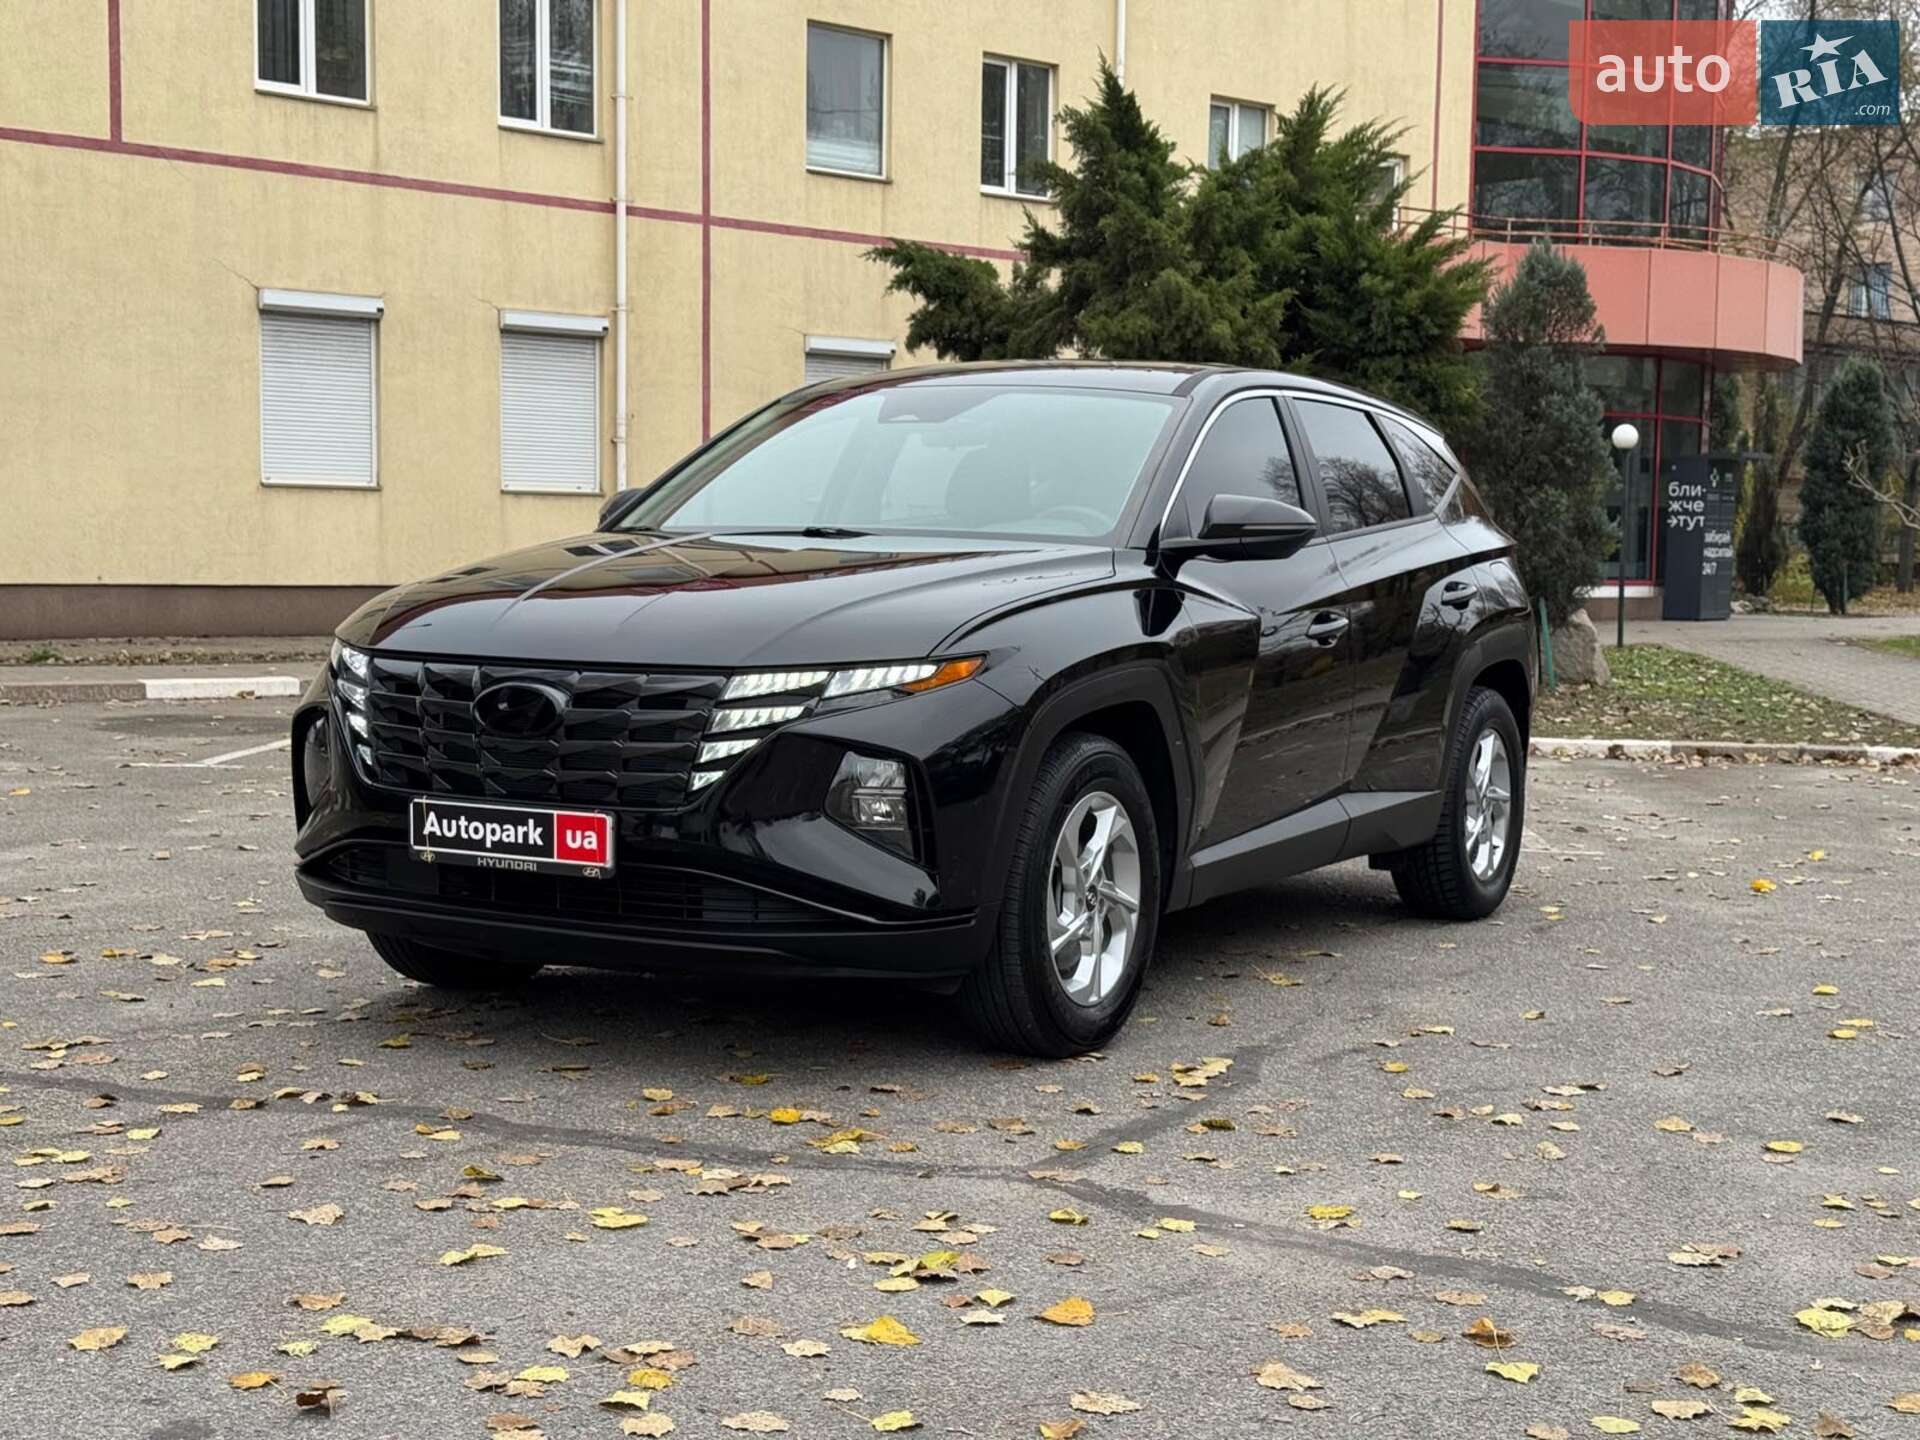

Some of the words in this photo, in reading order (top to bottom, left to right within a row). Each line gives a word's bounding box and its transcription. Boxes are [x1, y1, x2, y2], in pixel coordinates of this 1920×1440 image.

[1668, 500, 1704, 512] жче
[1677, 515, 1705, 531] тут
[423, 811, 544, 848] Autopark
[565, 829, 598, 850] ua
[477, 857, 537, 872] HYUNDAI
